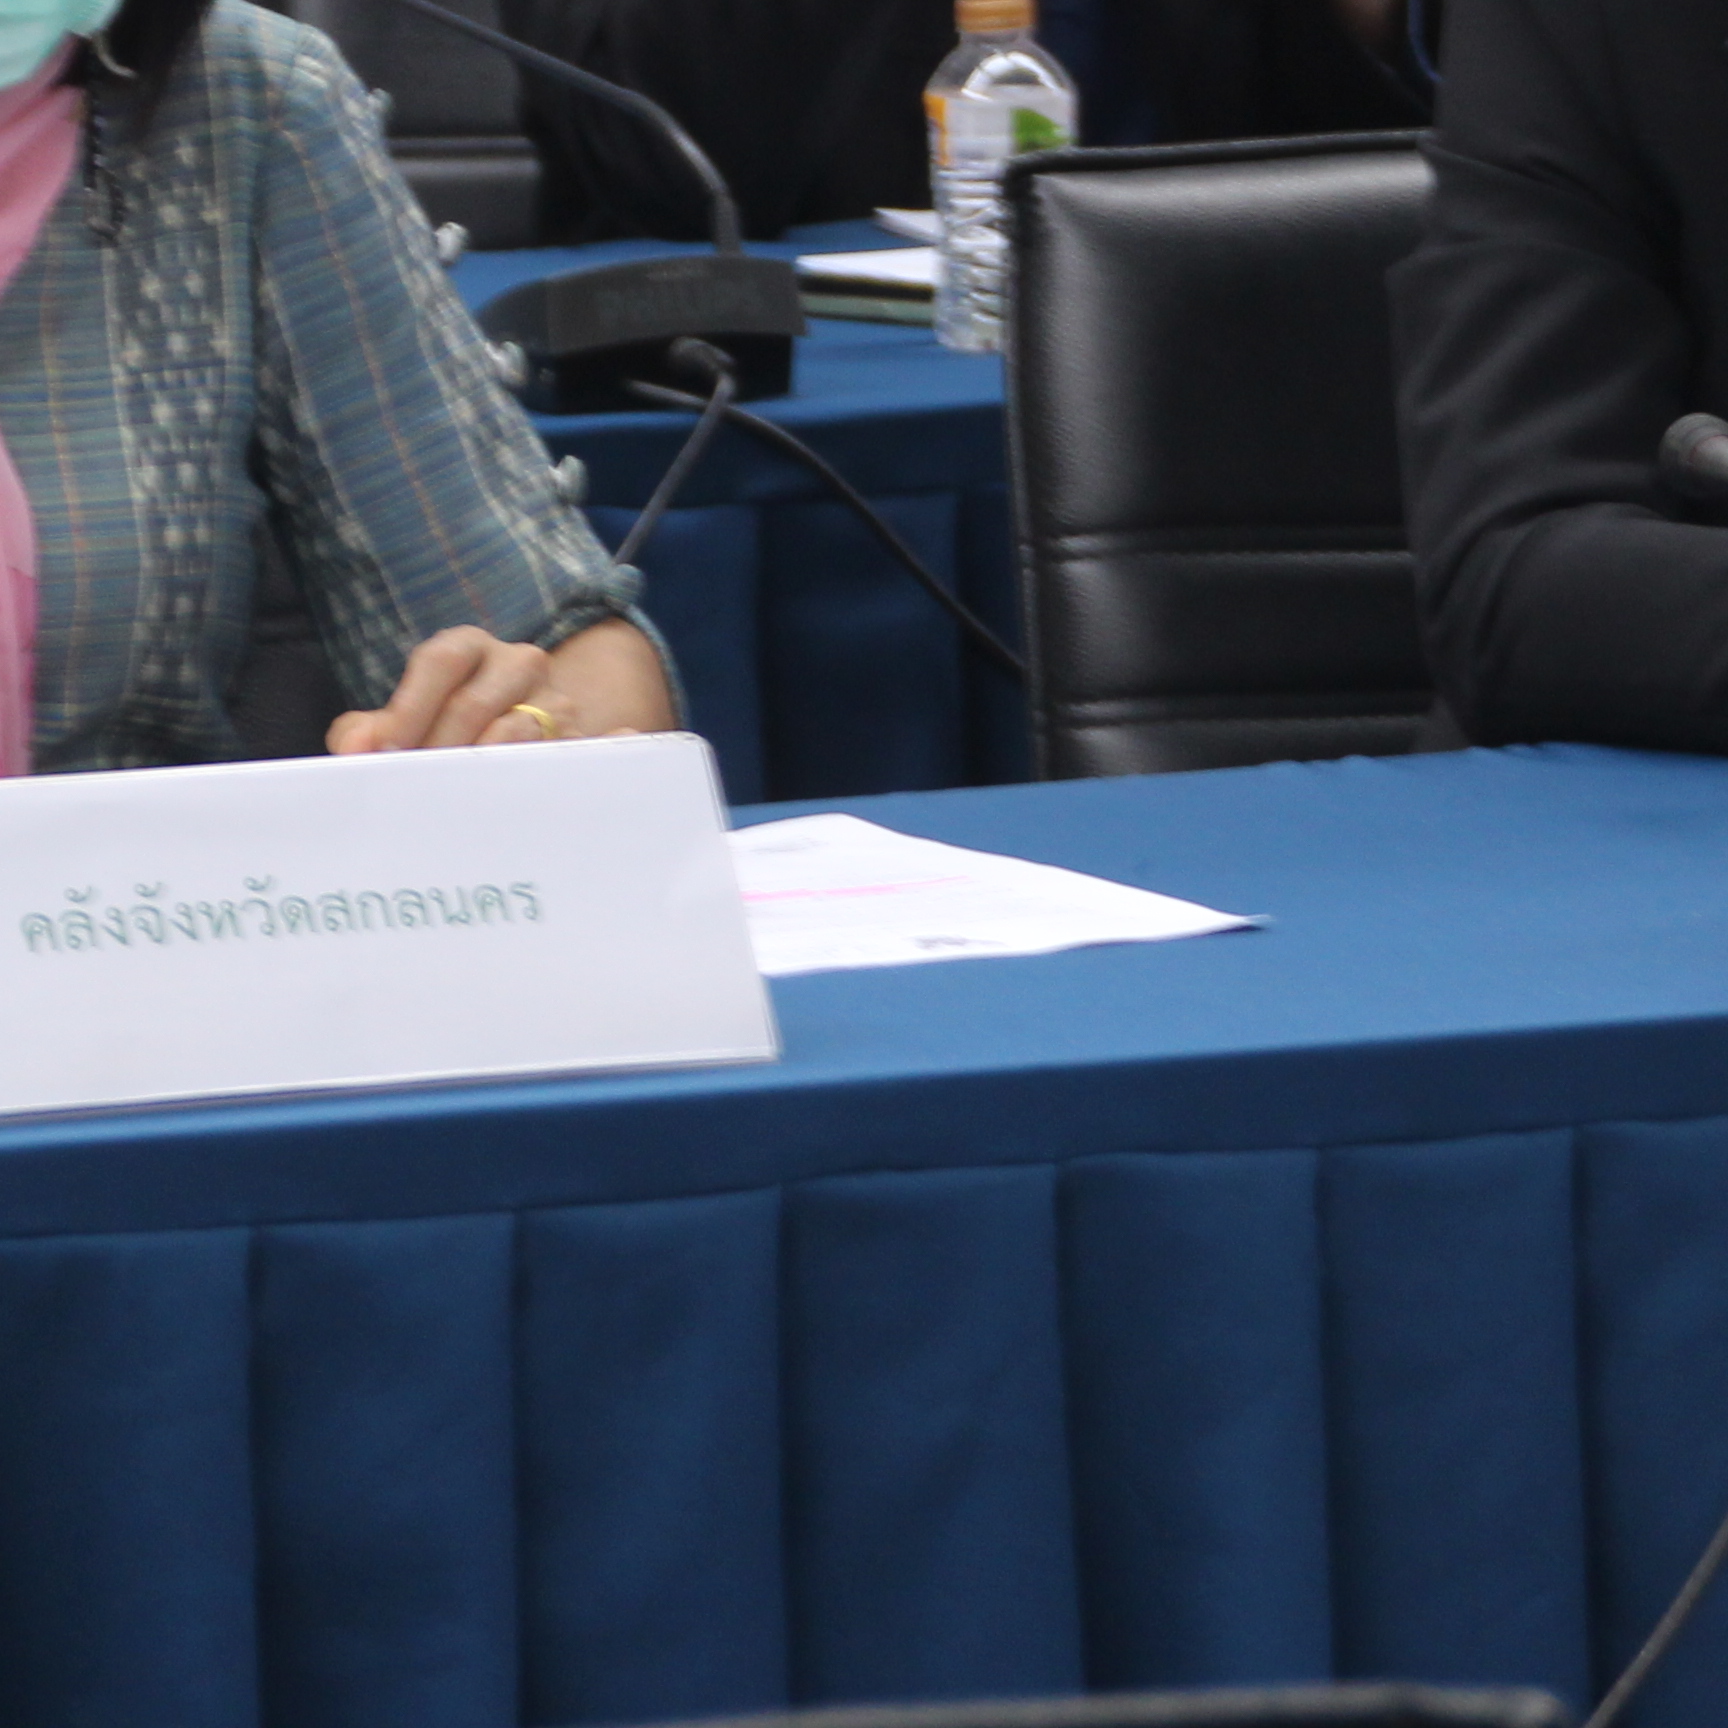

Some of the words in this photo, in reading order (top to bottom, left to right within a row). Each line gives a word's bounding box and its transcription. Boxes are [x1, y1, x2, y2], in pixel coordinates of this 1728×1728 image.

[18, 874, 543, 953] คลังจังหวัดสกลนคร
